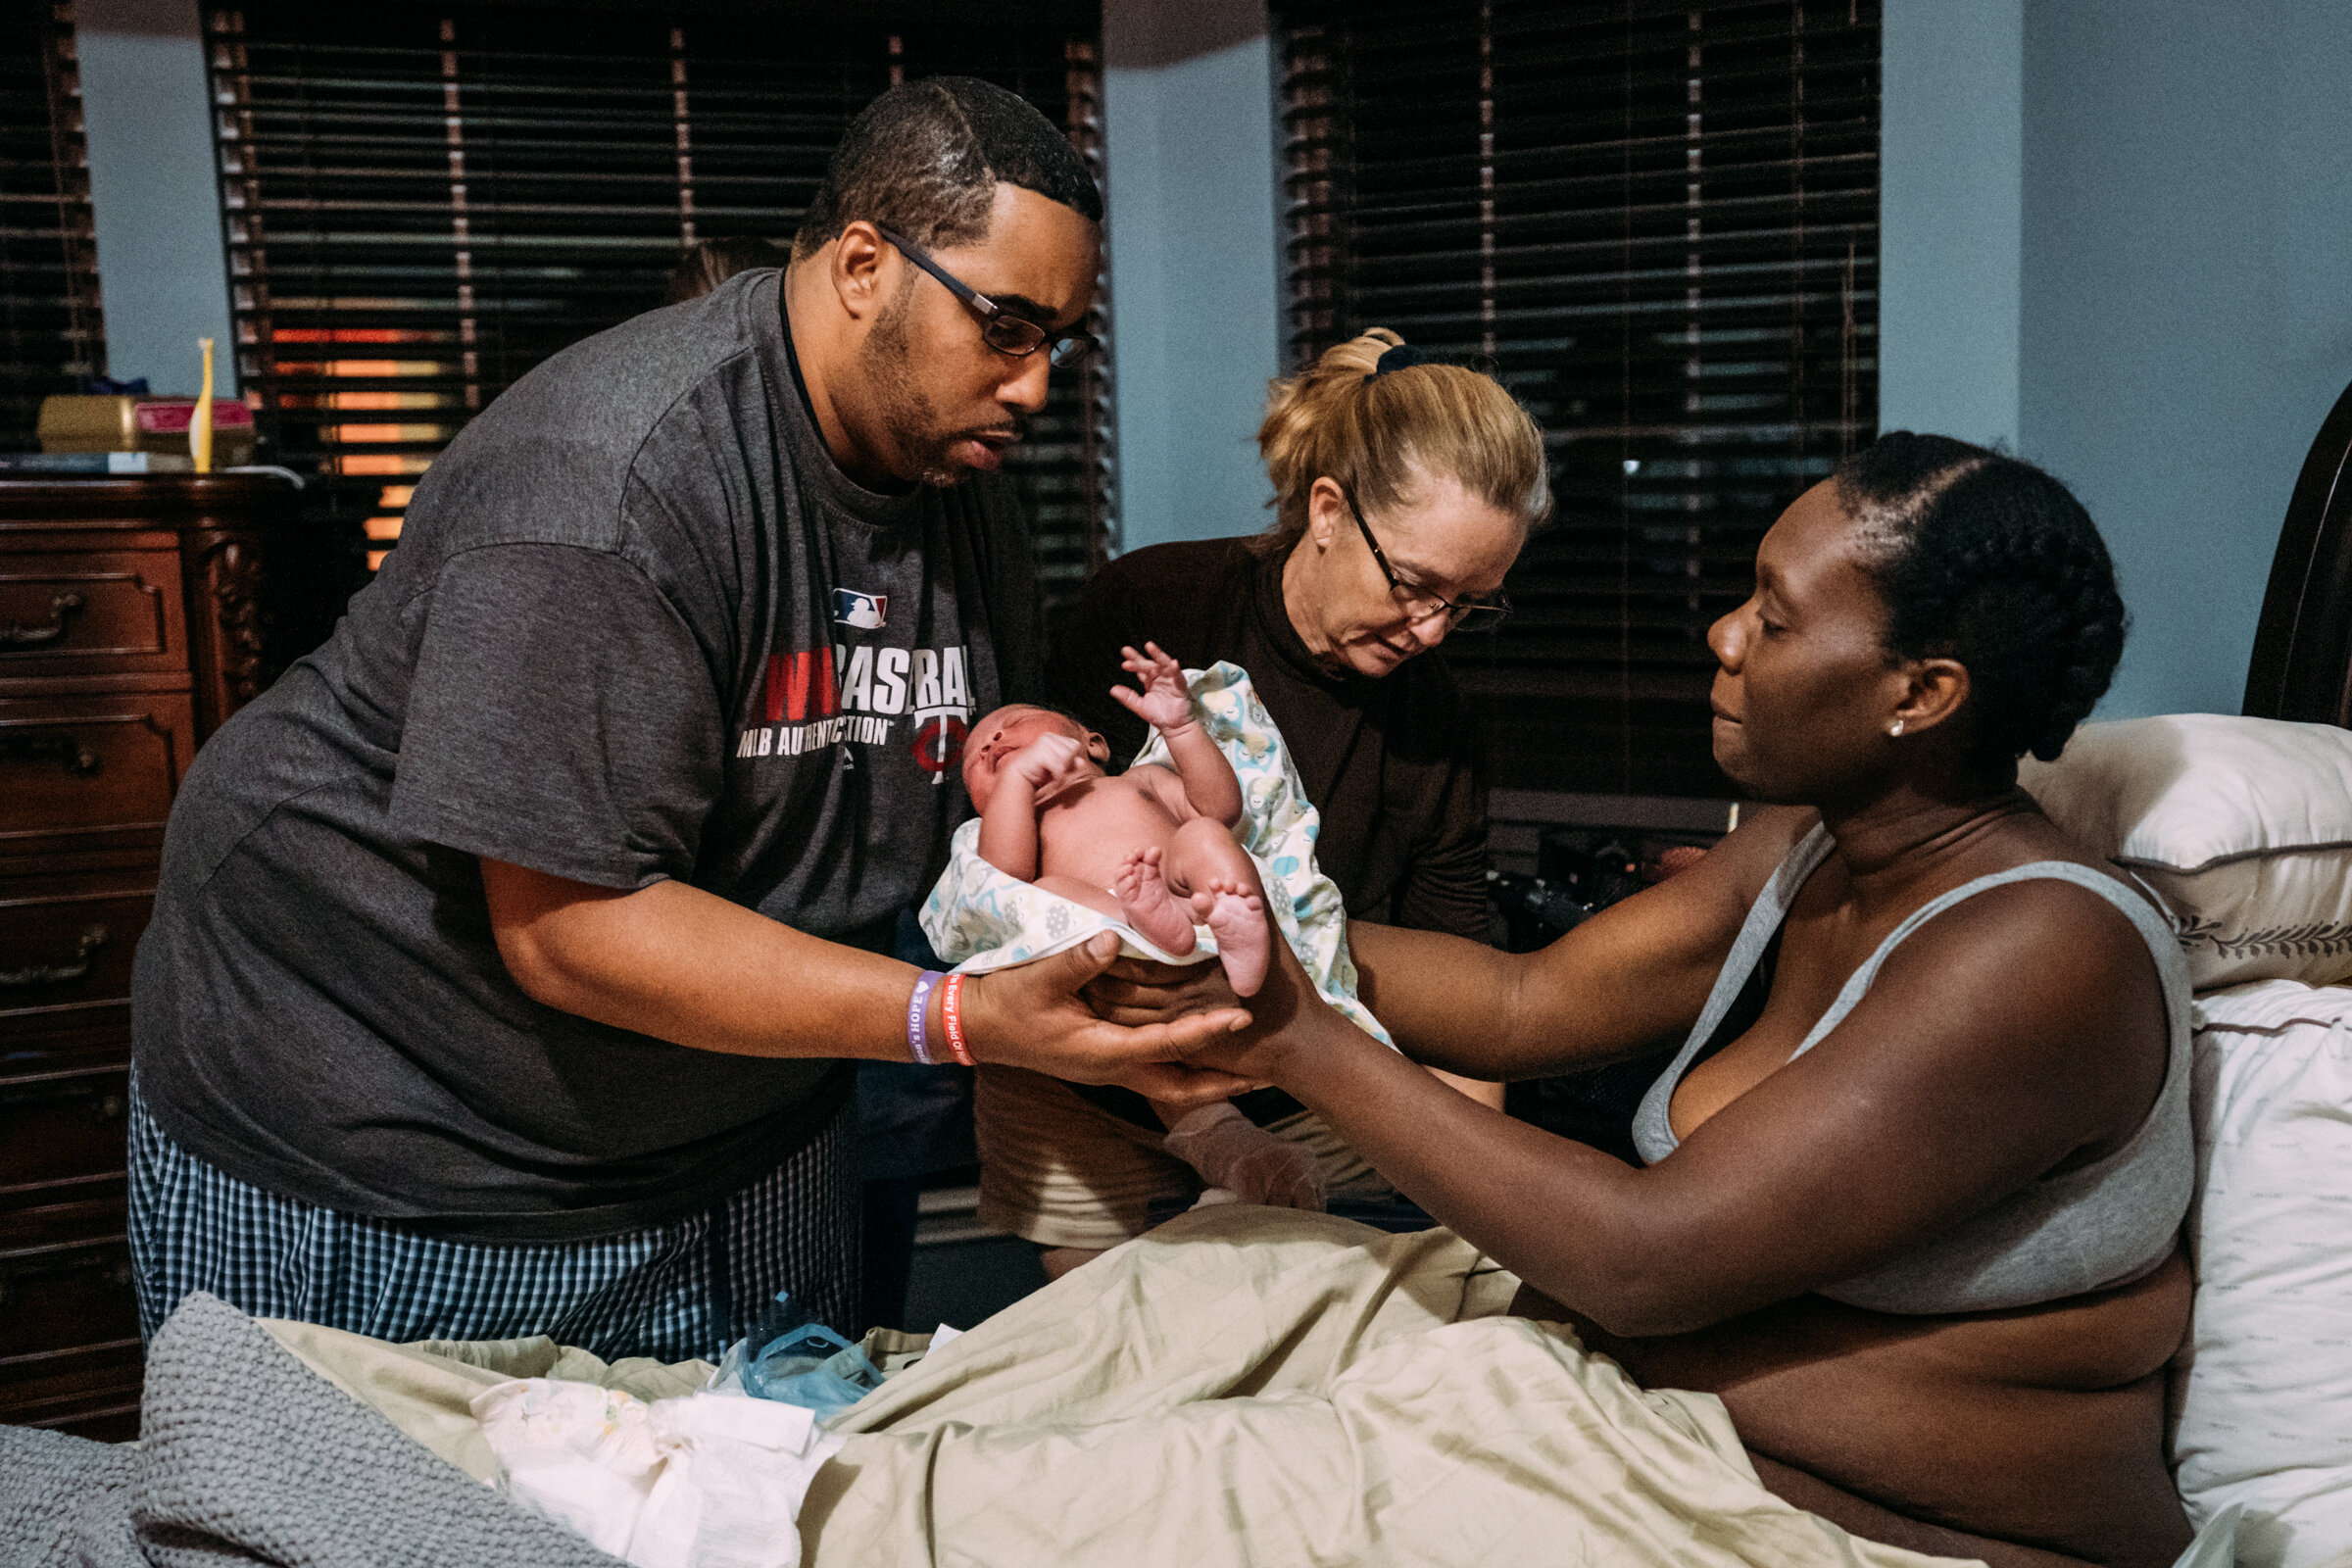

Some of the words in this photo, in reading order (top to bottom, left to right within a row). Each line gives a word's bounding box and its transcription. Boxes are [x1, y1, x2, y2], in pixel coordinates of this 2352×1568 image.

[736, 727, 771, 759] MLB
[945, 984, 957, 1013] Every
[910, 996, 923, 1033] HOPE
[948, 1015, 958, 1040] Field
